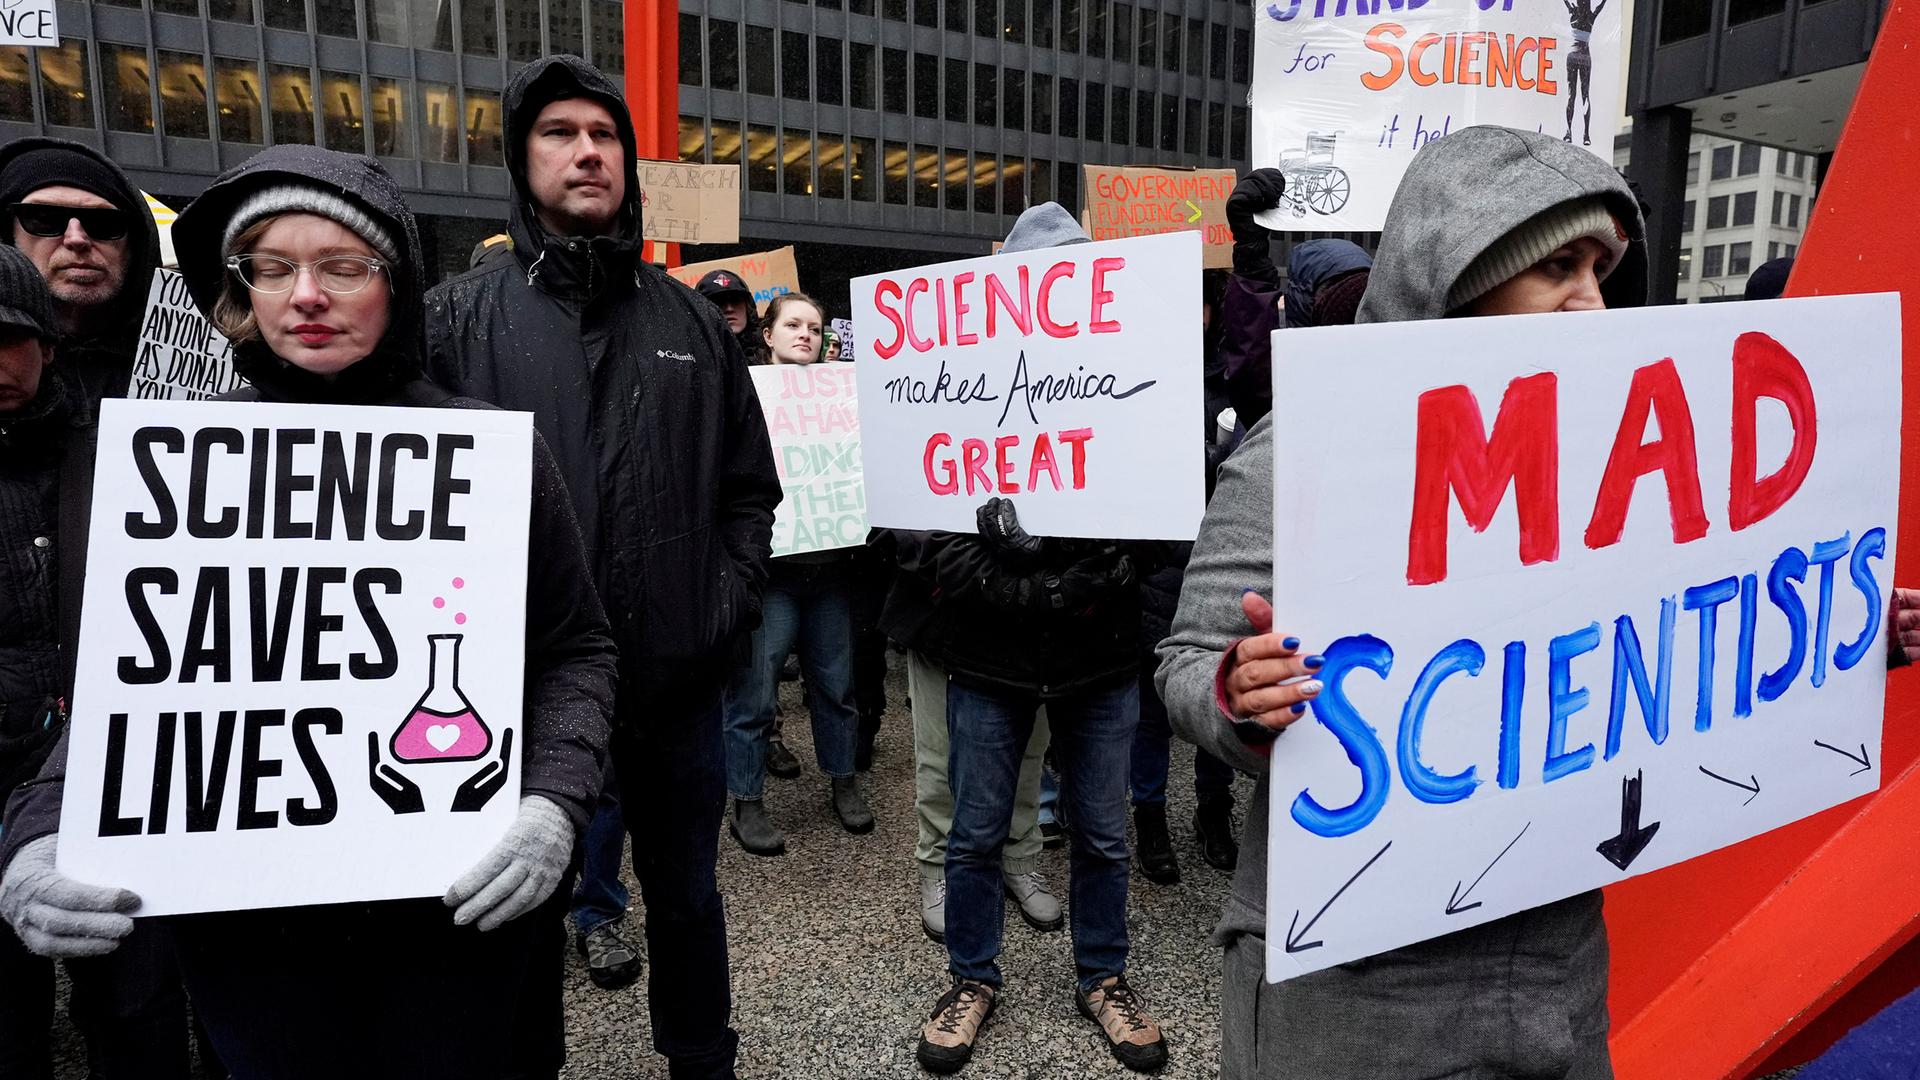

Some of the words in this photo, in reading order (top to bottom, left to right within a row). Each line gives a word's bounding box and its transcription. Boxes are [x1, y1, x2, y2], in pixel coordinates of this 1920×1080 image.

[1283, 42, 1336, 74] for
[1360, 22, 1557, 95] SCIENCE
[1378, 114, 1399, 148] it
[1096, 173, 1234, 203] GOVERNMENT
[1097, 201, 1185, 226] FUNDING
[142, 304, 217, 357] ANYONE
[873, 257, 1126, 360] SCIENCE
[134, 342, 163, 381] AS
[884, 361, 998, 405] makes
[997, 350, 1157, 428] America
[125, 426, 474, 541] SCIENCE
[923, 427, 1095, 497] GREAT
[1406, 331, 1817, 586] MAD
[117, 566, 402, 685] SAVES
[1290, 527, 1886, 838] SCIENTISTS
[97, 707, 344, 837] LIVES
